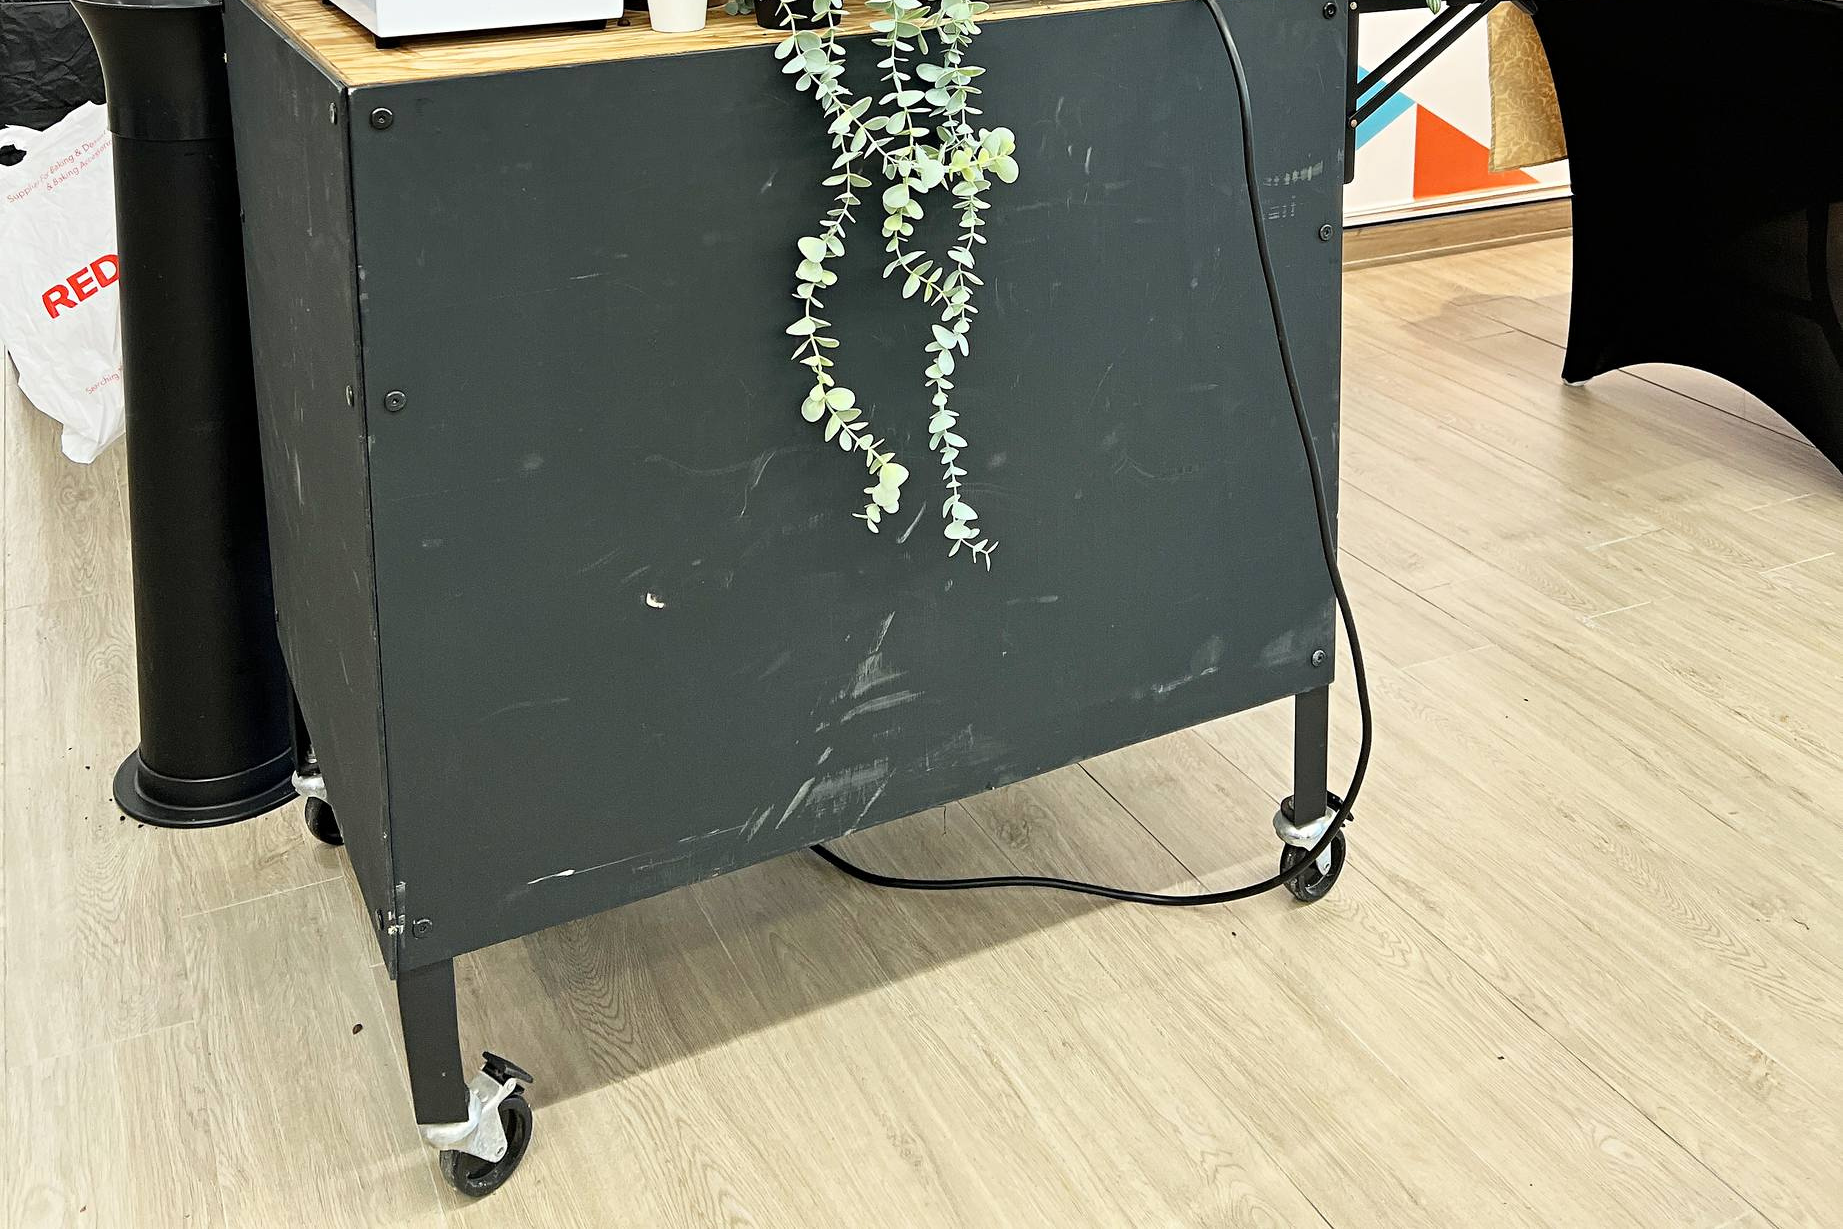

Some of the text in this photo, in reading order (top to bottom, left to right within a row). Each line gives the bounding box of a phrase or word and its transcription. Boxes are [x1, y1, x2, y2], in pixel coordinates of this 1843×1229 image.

[49, 154, 75, 174] Baking
[74, 148, 82, 158] &
[46, 182, 54, 192] &
[53, 166, 80, 187] Baking
[42, 254, 120, 319] RED
